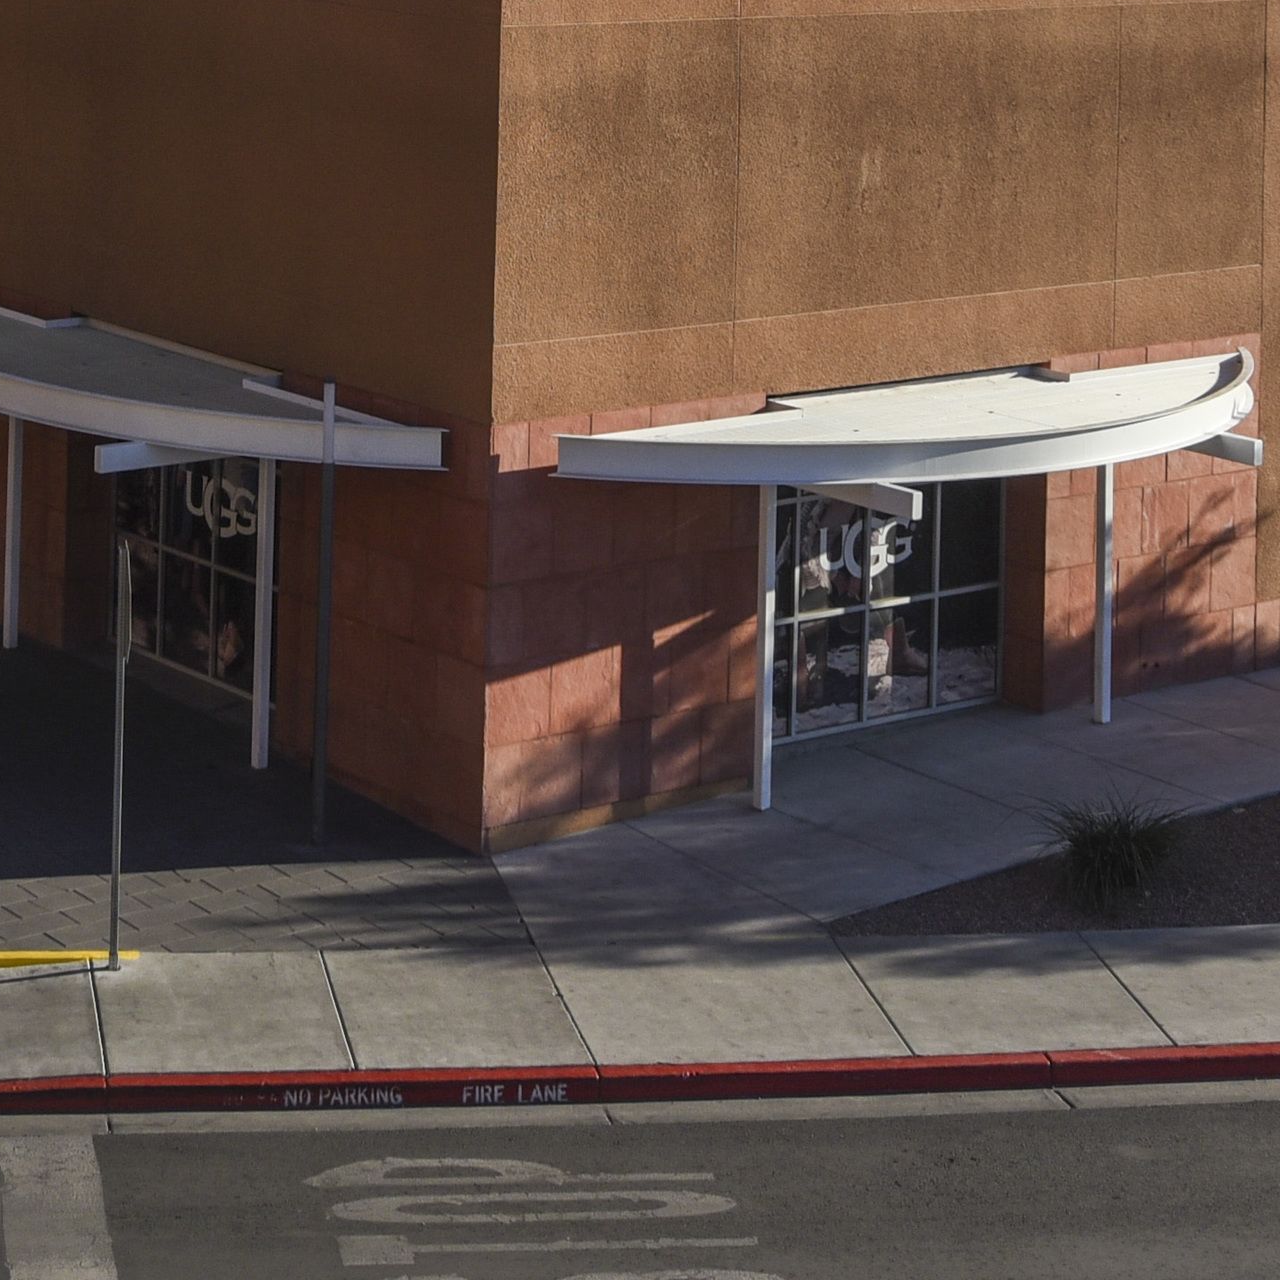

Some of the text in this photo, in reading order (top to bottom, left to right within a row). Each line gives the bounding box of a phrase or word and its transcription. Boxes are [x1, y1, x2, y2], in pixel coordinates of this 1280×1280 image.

[185, 470, 257, 539] UGG
[819, 515, 915, 579] UGG
[283, 1089, 312, 1107] NO
[320, 1086, 403, 1105] PARKING
[462, 1085, 504, 1103] FIRE
[517, 1083, 568, 1103] LANE
[303, 1156, 785, 1280] TOP
